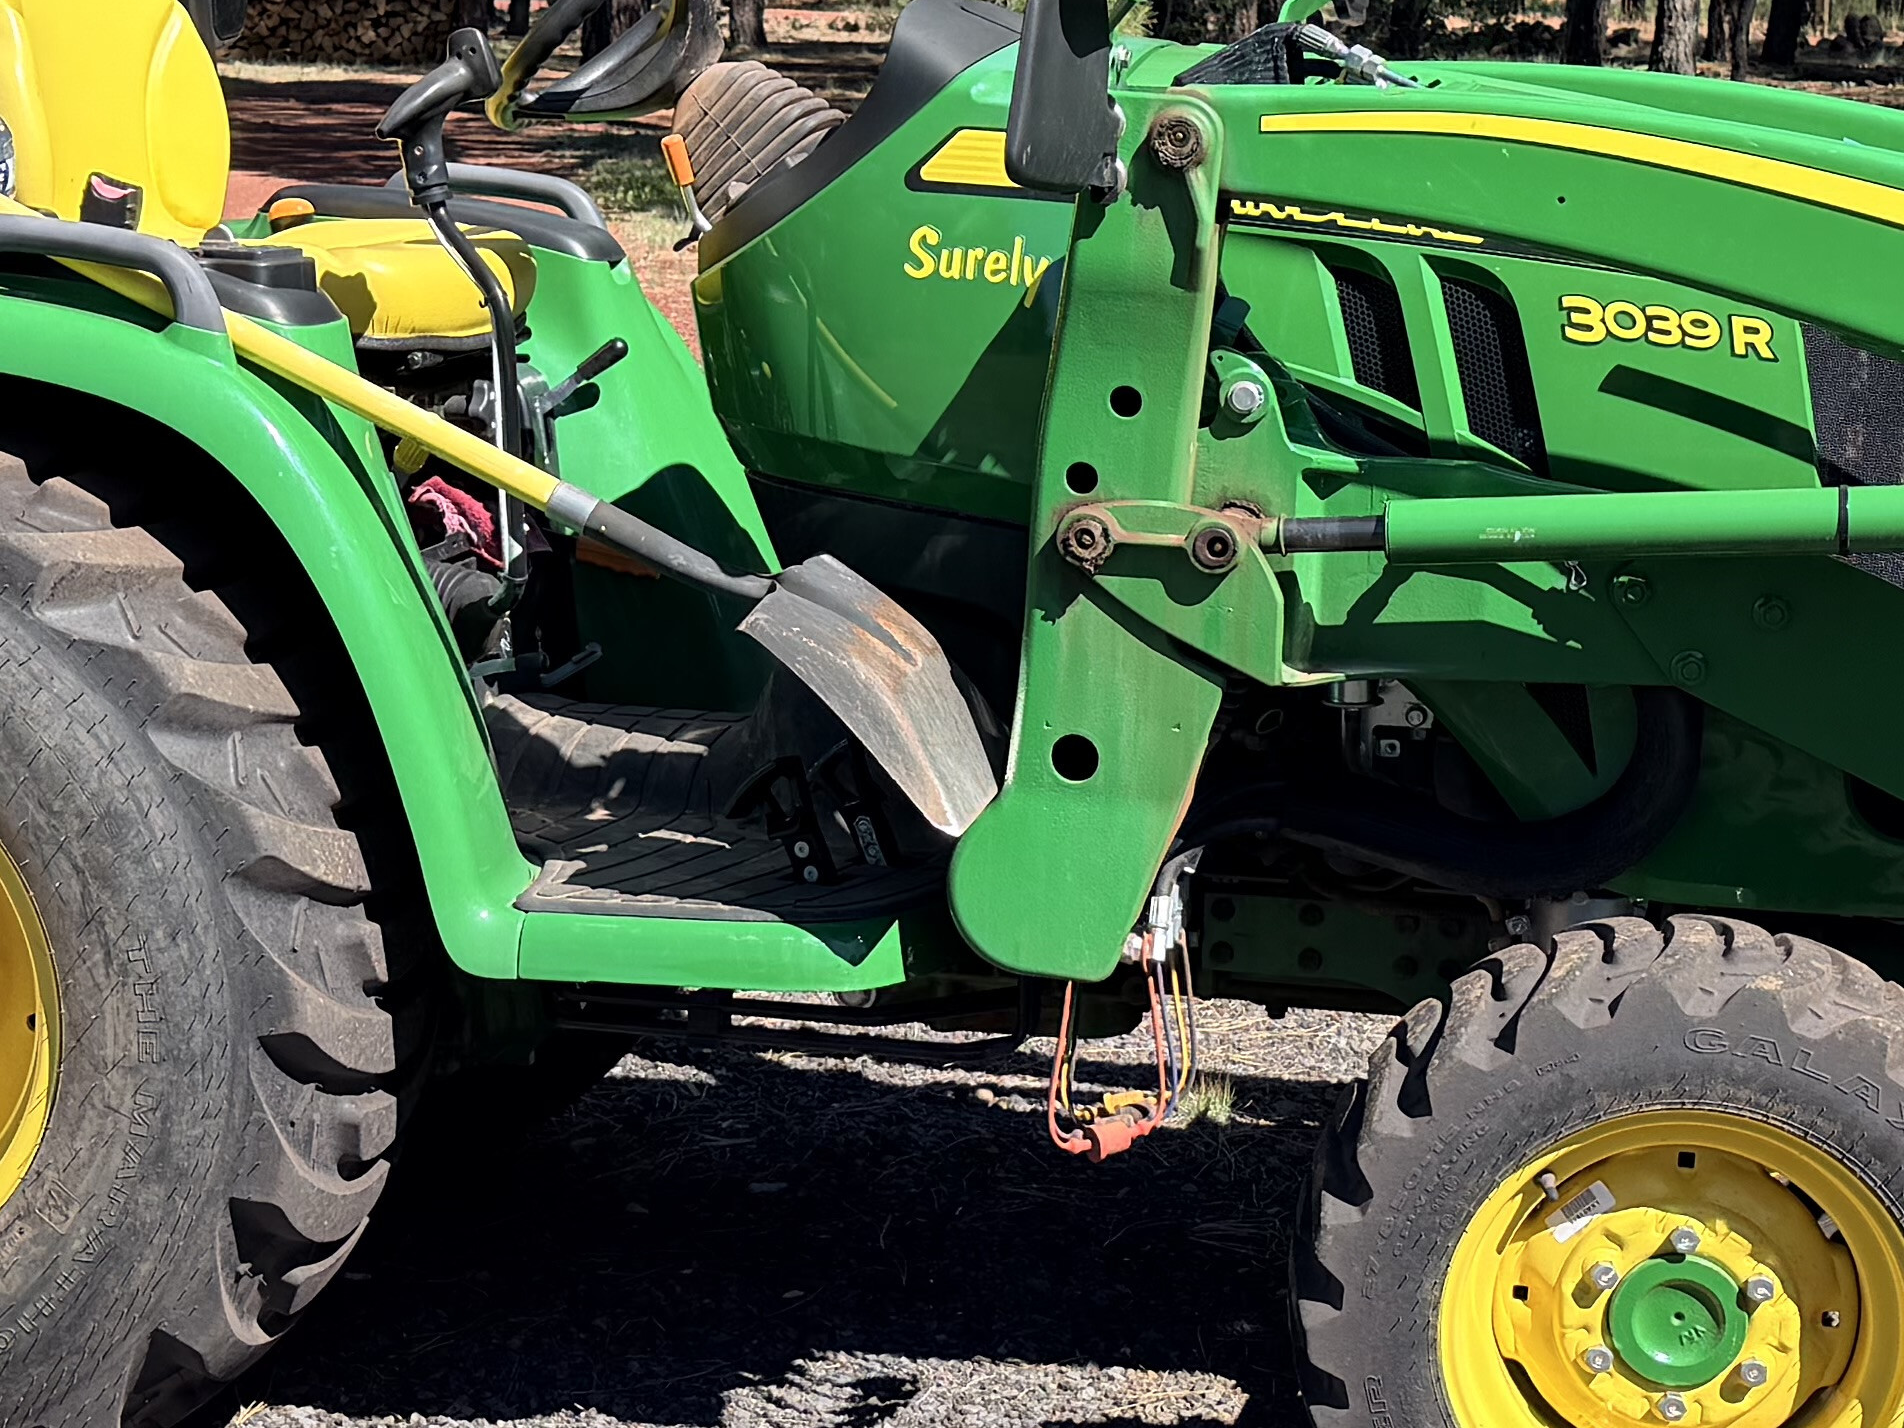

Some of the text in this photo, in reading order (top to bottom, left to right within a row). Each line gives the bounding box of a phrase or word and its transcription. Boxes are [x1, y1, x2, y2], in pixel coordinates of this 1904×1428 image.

[904, 224, 1053, 308] Surely
[1559, 294, 1779, 361] 3039 R
[126, 933, 159, 1065] THE
